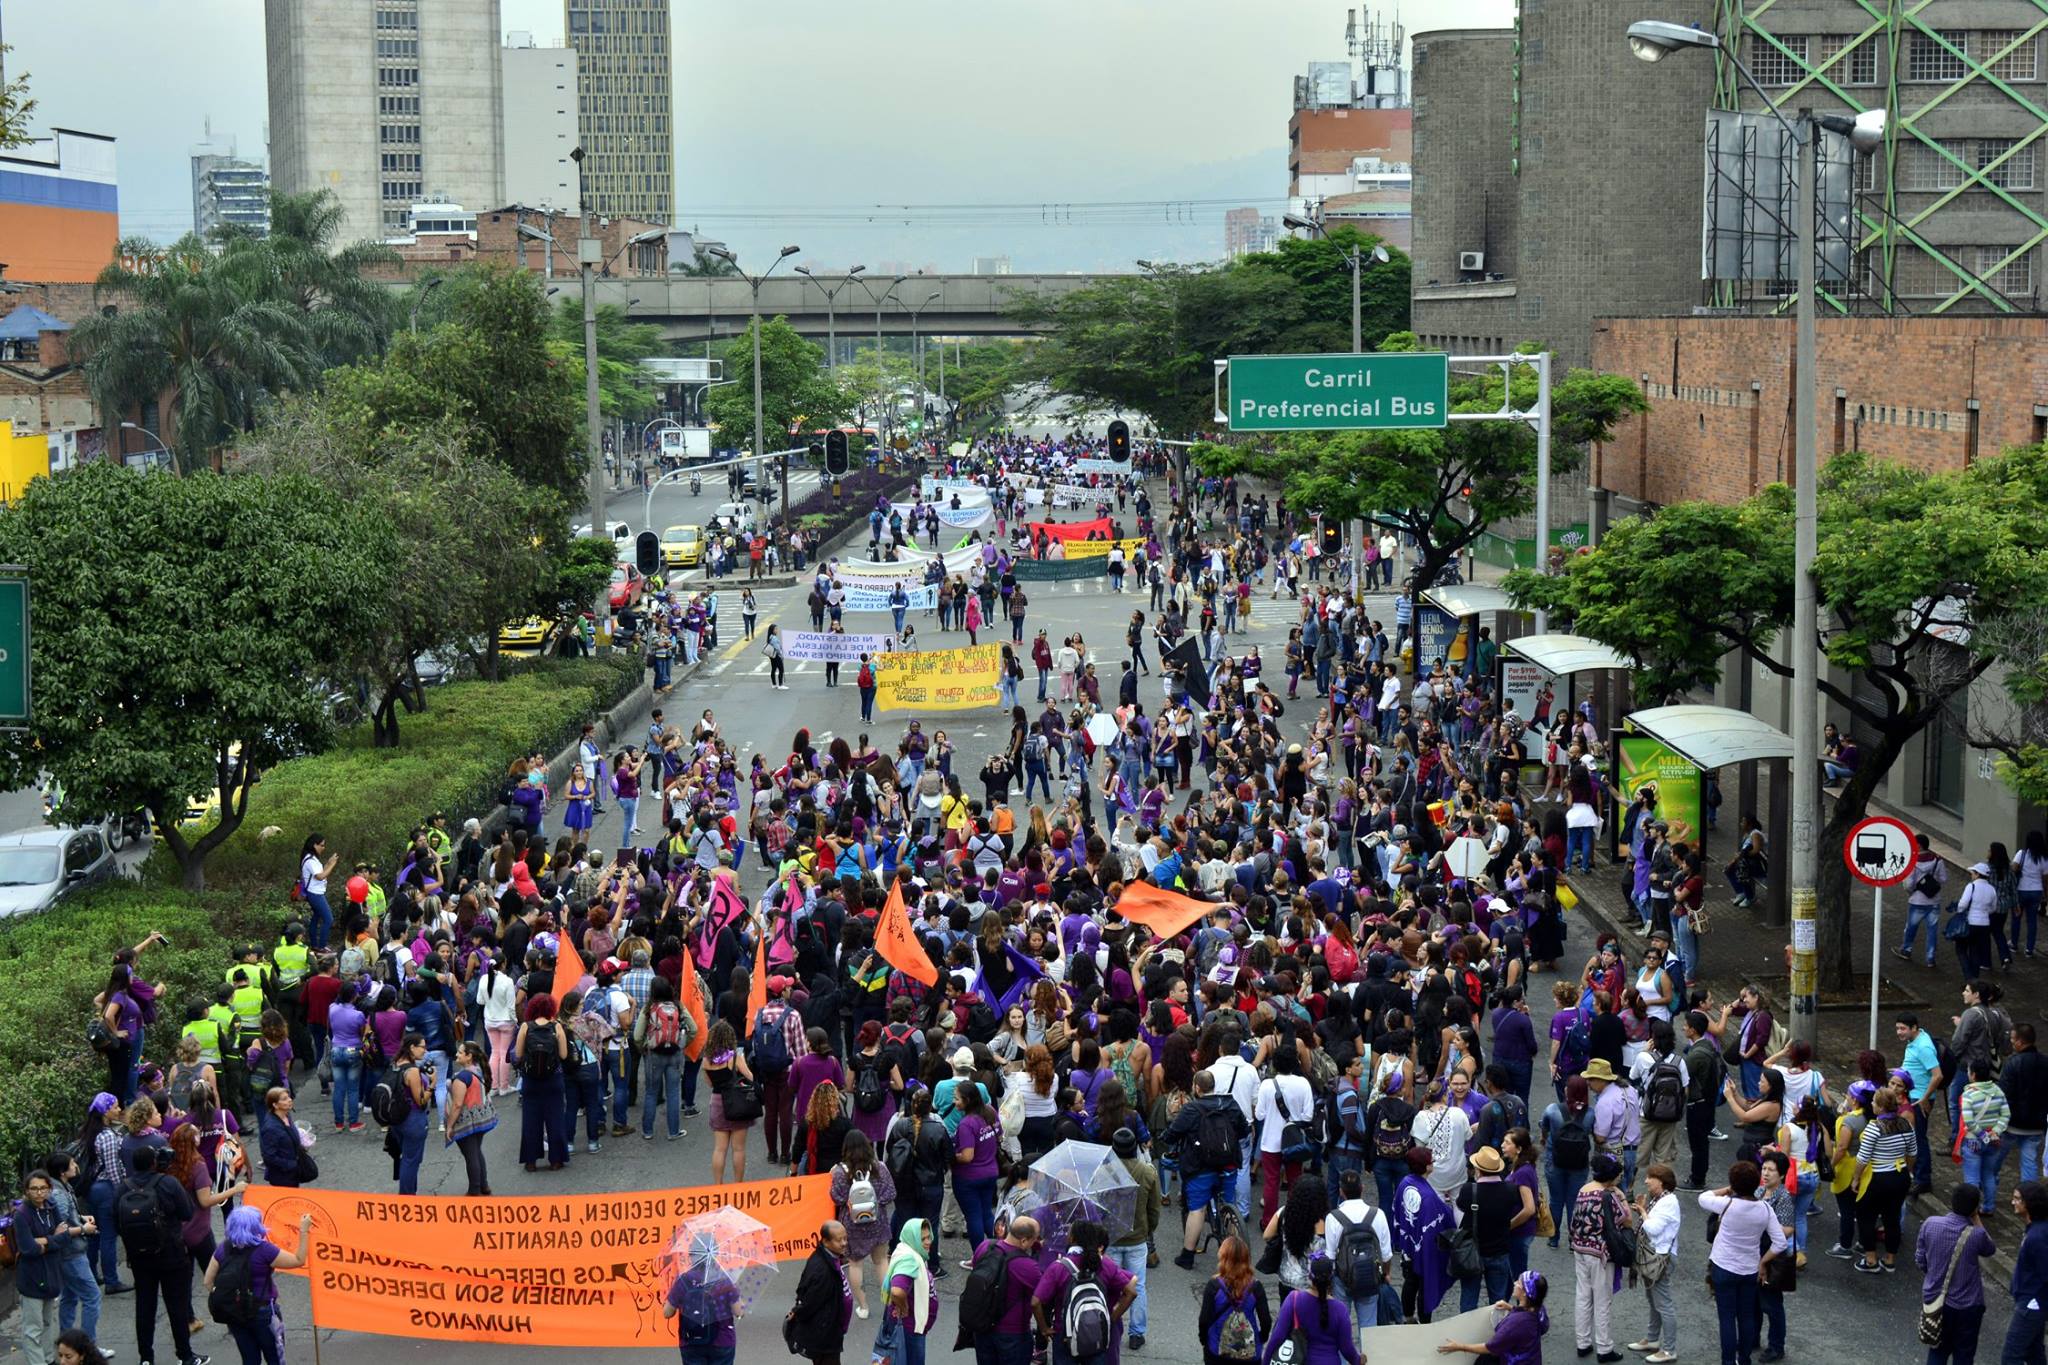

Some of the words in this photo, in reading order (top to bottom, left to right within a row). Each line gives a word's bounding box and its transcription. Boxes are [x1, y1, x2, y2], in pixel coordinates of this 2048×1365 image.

[1304, 368, 1371, 388] Carril
[1240, 399, 1380, 418] Preferencial
[1391, 397, 1436, 416] Bus
[1420, 613, 1441, 624] LLENA
[1420, 624, 1444, 635] MENOS
[1420, 634, 1435, 645] CON
[1420, 645, 1438, 655] TODO
[1439, 645, 1446, 655] EL
[1420, 655, 1441, 666] SAB
